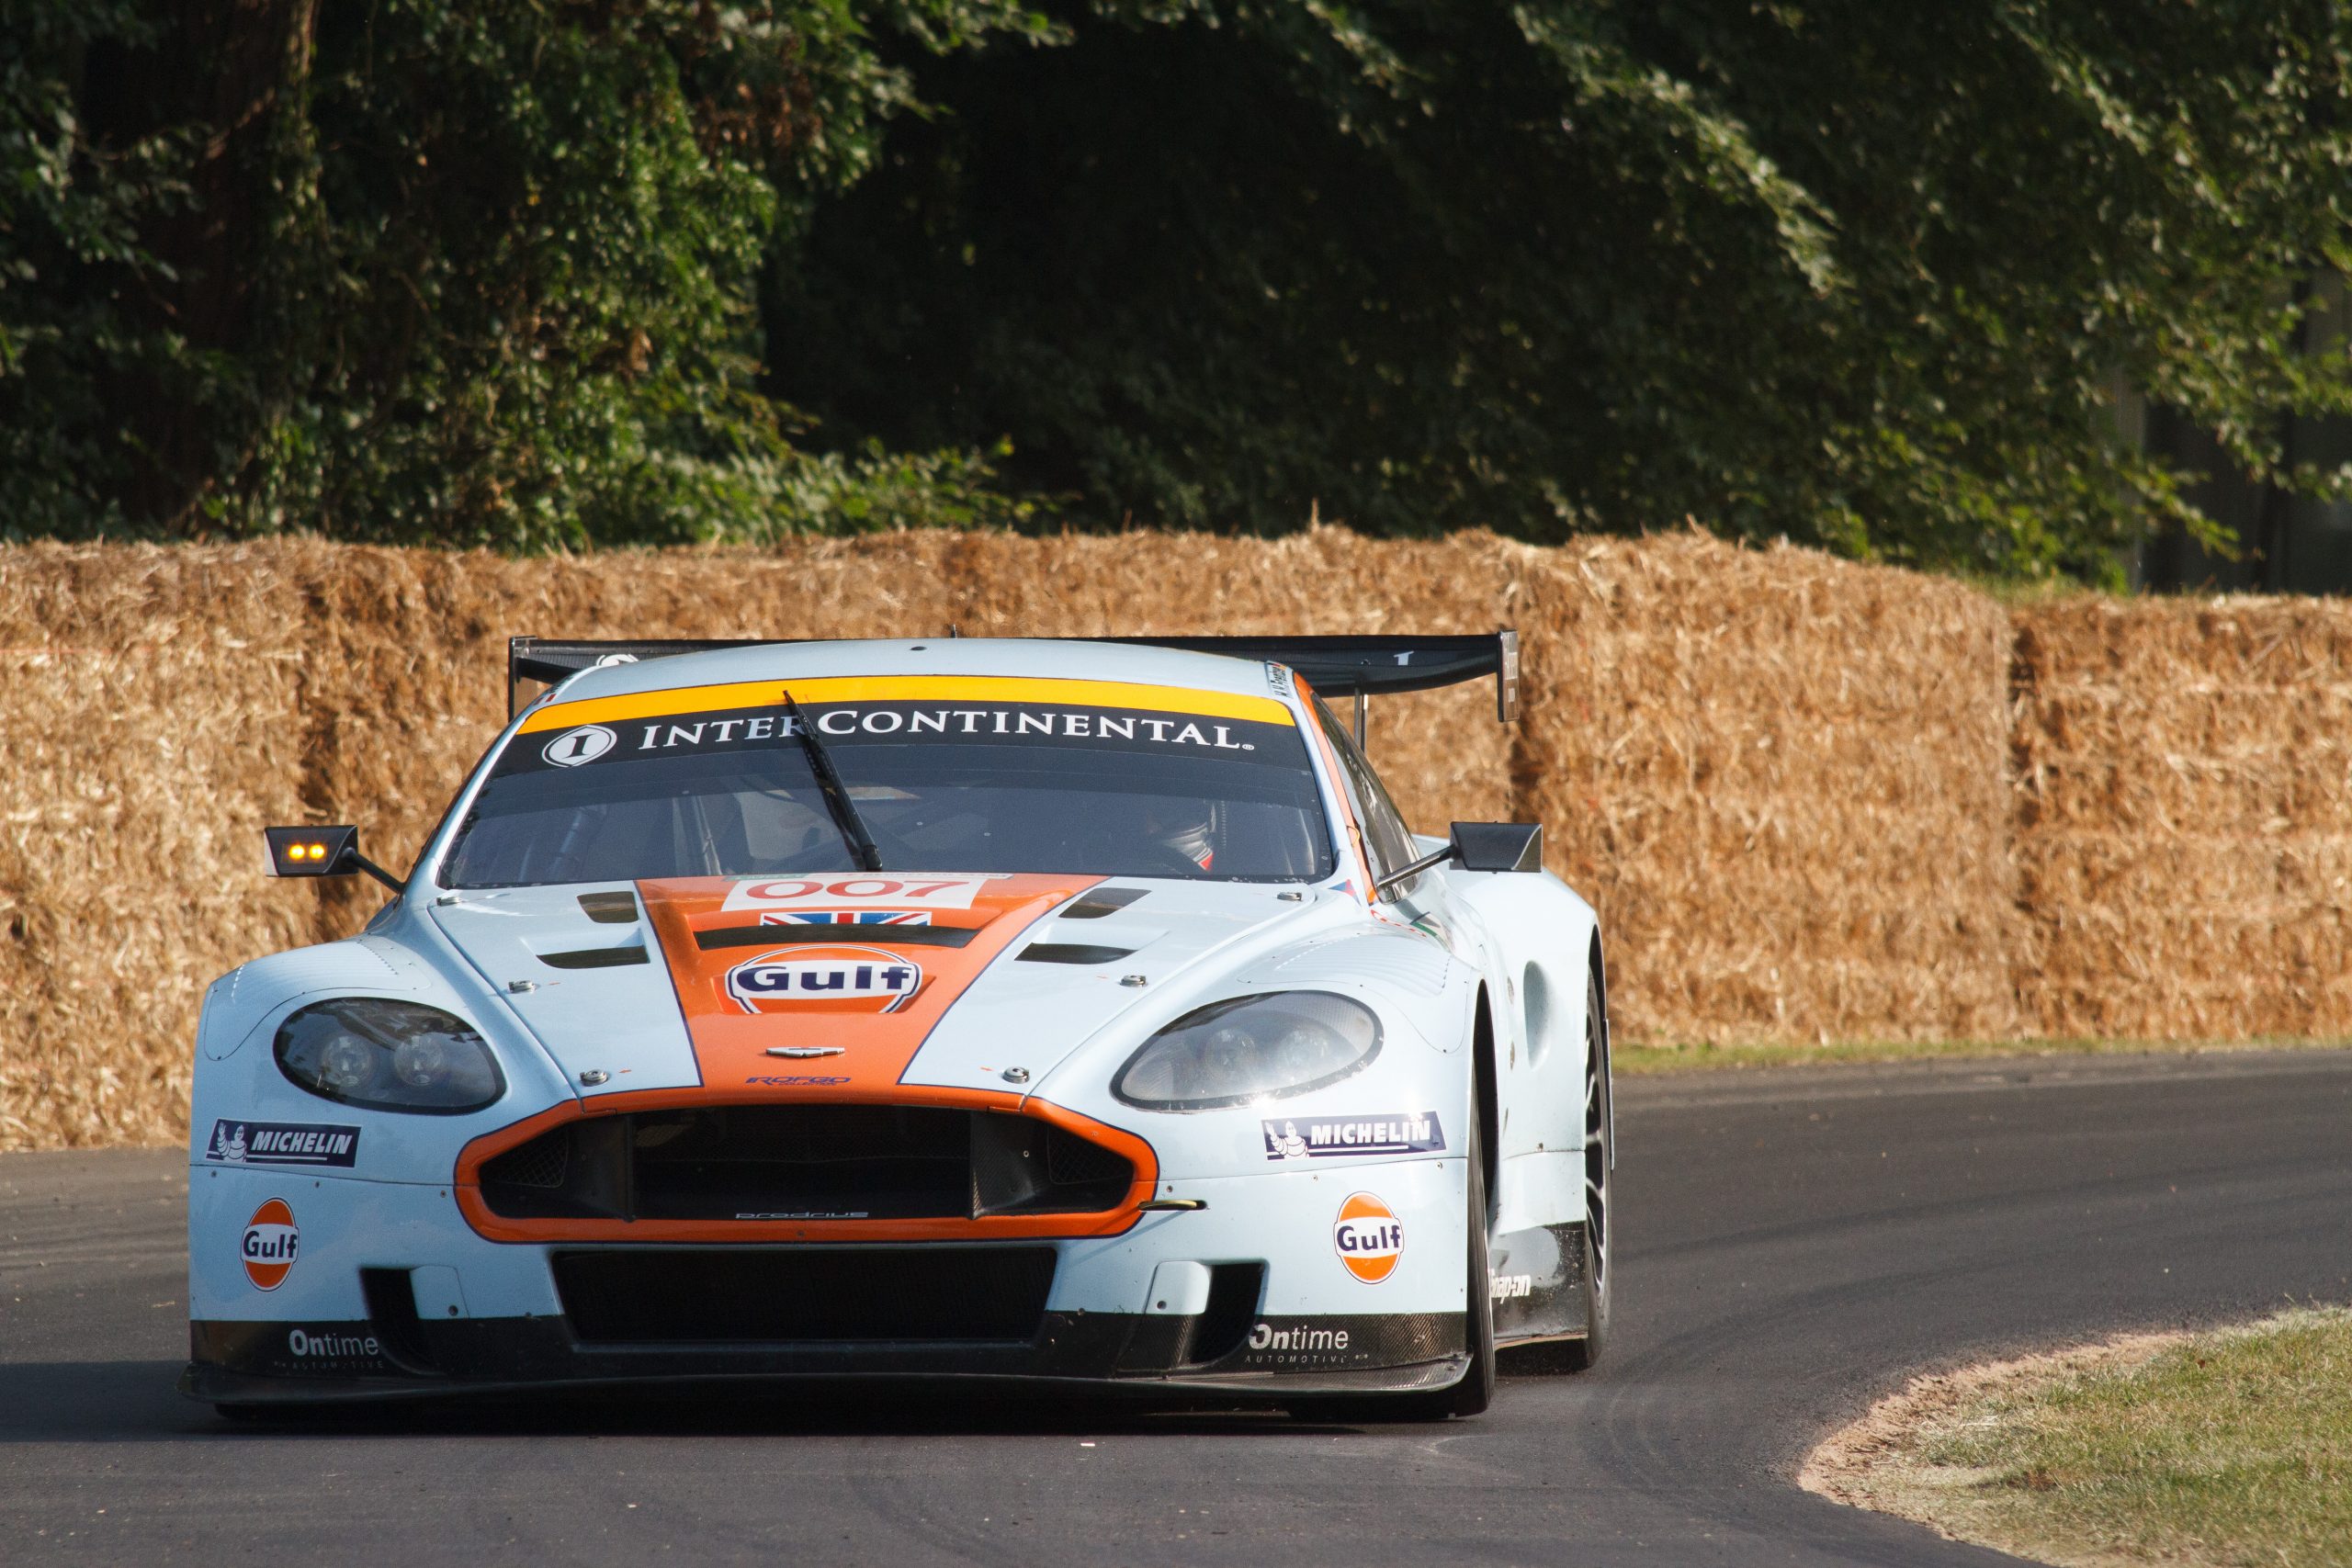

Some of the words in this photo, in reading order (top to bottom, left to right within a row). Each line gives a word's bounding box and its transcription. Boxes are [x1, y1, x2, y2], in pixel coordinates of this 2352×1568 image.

[746, 880, 970, 898] 007
[736, 965, 912, 992] Gulf
[251, 1130, 353, 1156] MICHELIN
[1310, 1119, 1431, 1146] MICHELIN
[243, 1229, 298, 1259] Gulf
[1336, 1224, 1402, 1252] Gulf
[288, 1329, 379, 1356] Ontime
[1250, 1324, 1350, 1350] Ontime
